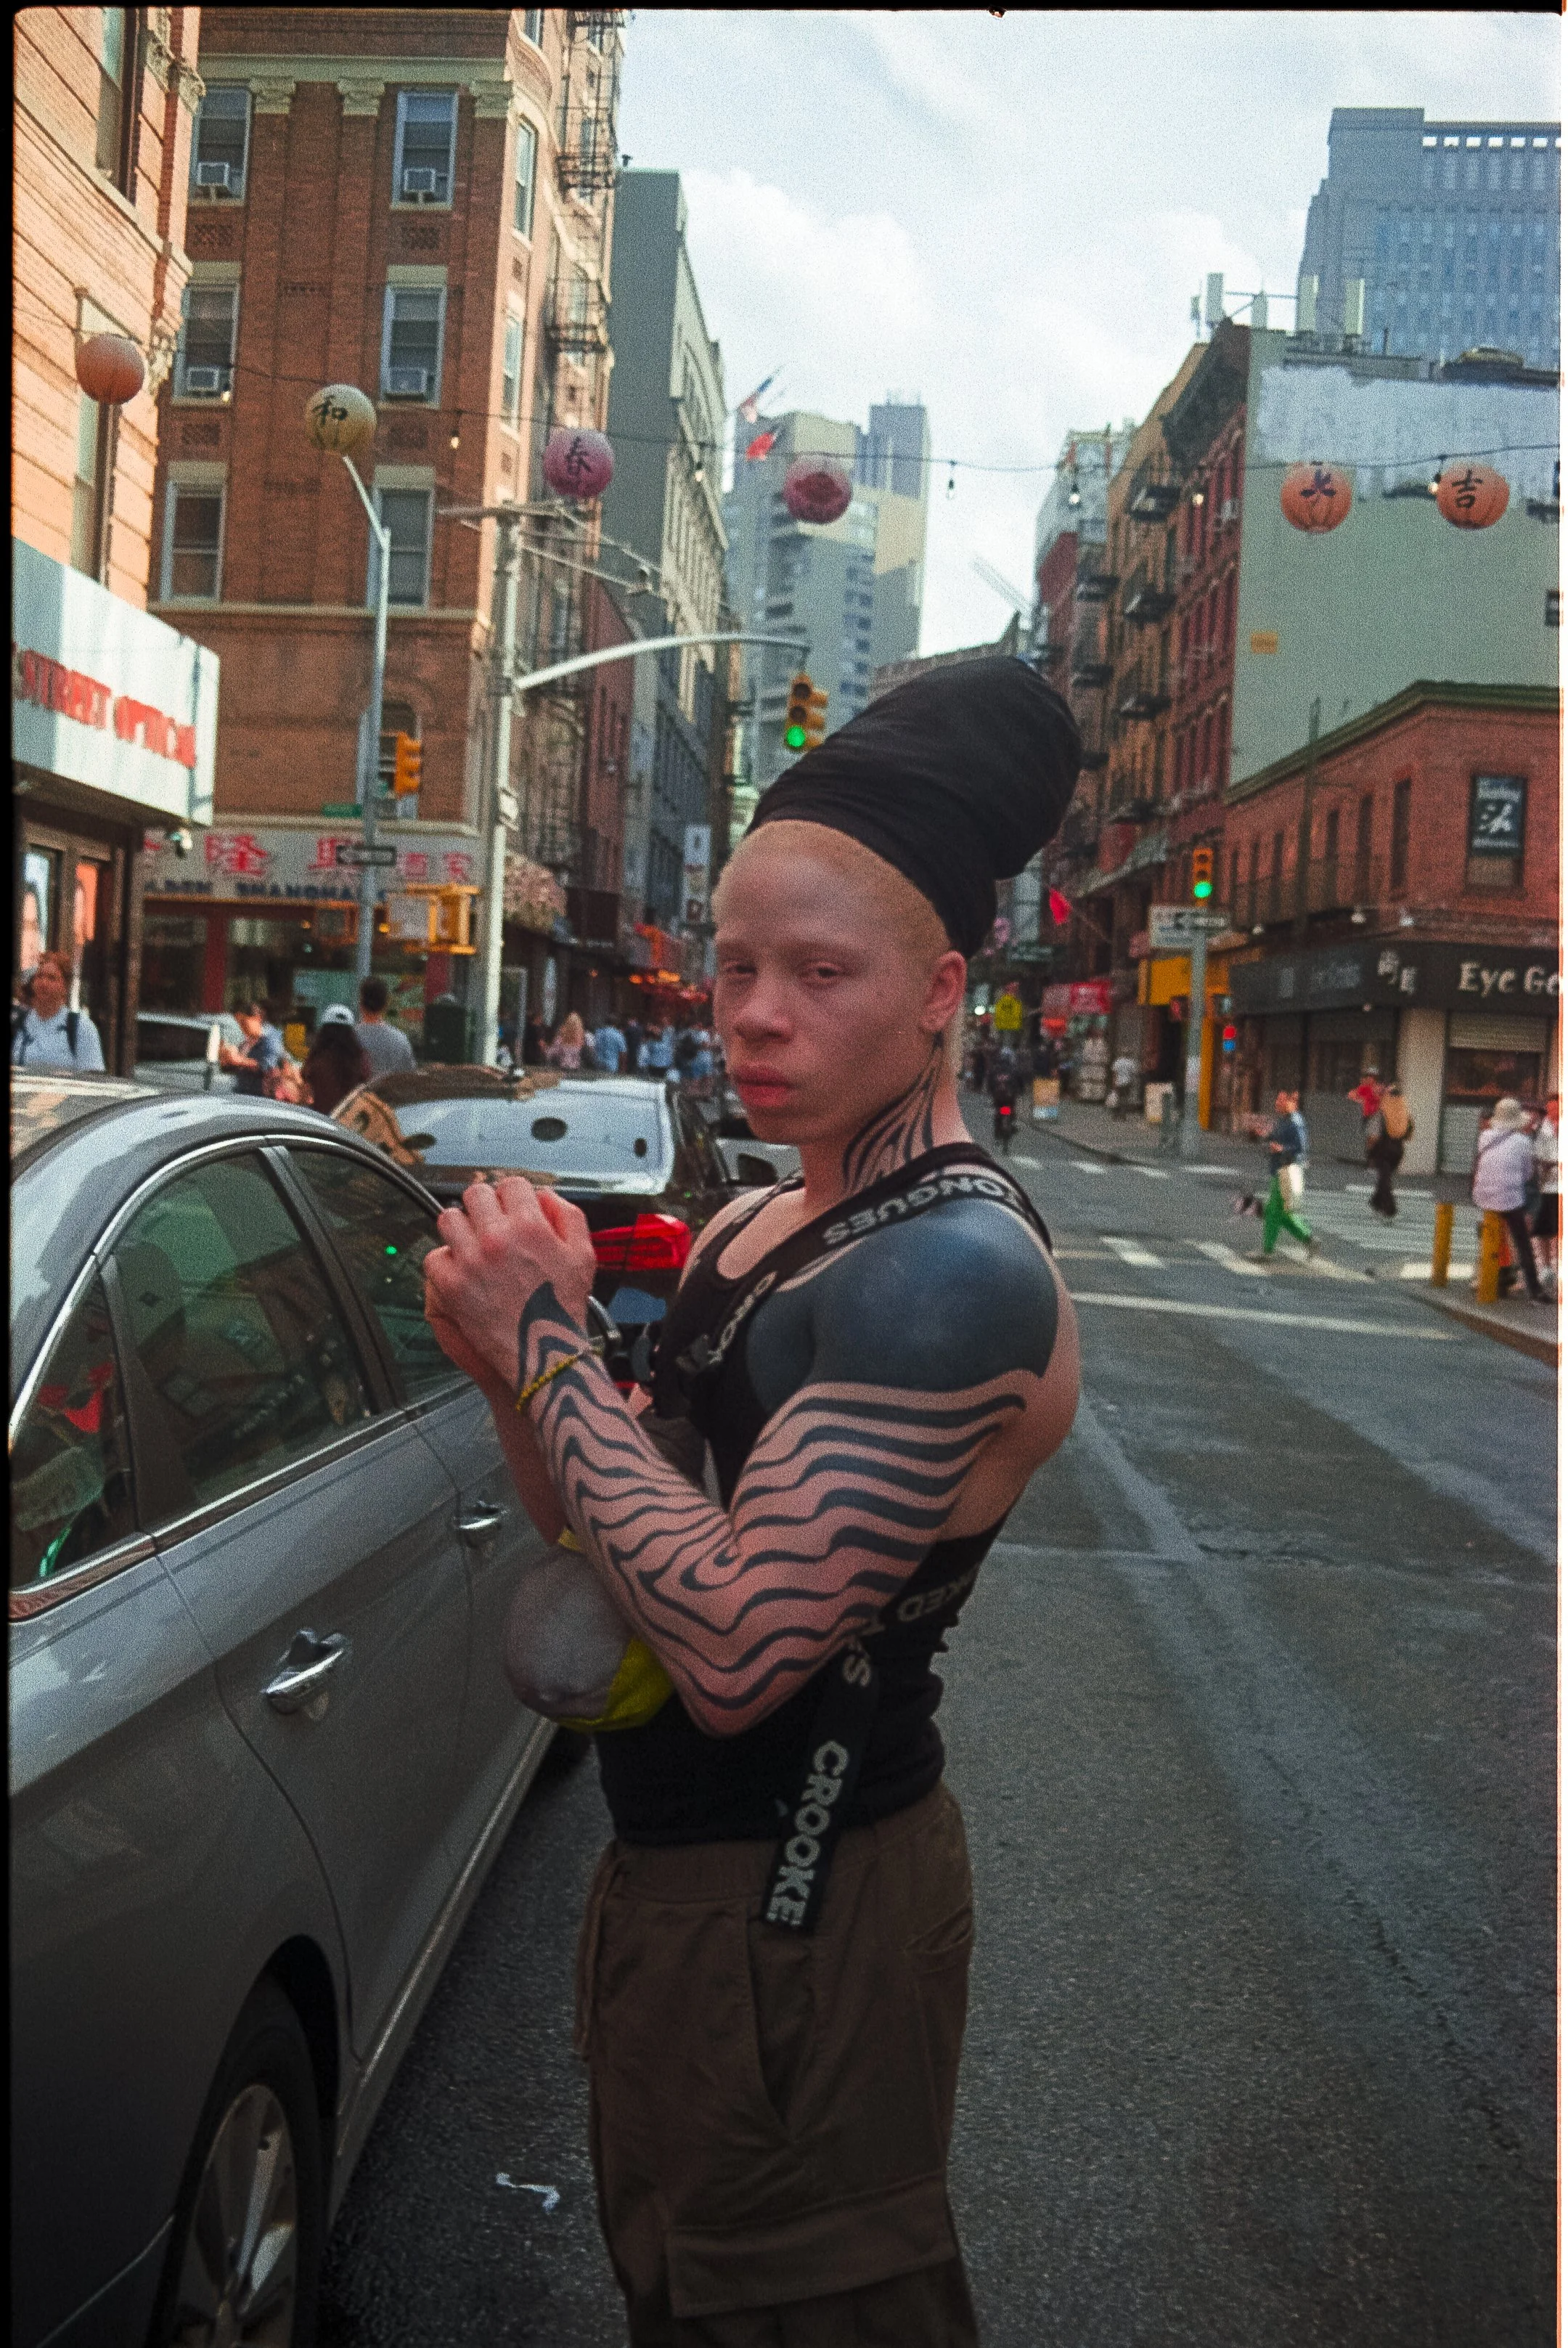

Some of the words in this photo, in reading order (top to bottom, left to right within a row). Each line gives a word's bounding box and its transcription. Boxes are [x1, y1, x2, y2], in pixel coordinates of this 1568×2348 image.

[311, 394, 348, 425] 和
[1452, 469, 1482, 509] 吉
[1456, 961, 1516, 998] Eye
[766, 1740, 851, 1926] CROOKE
